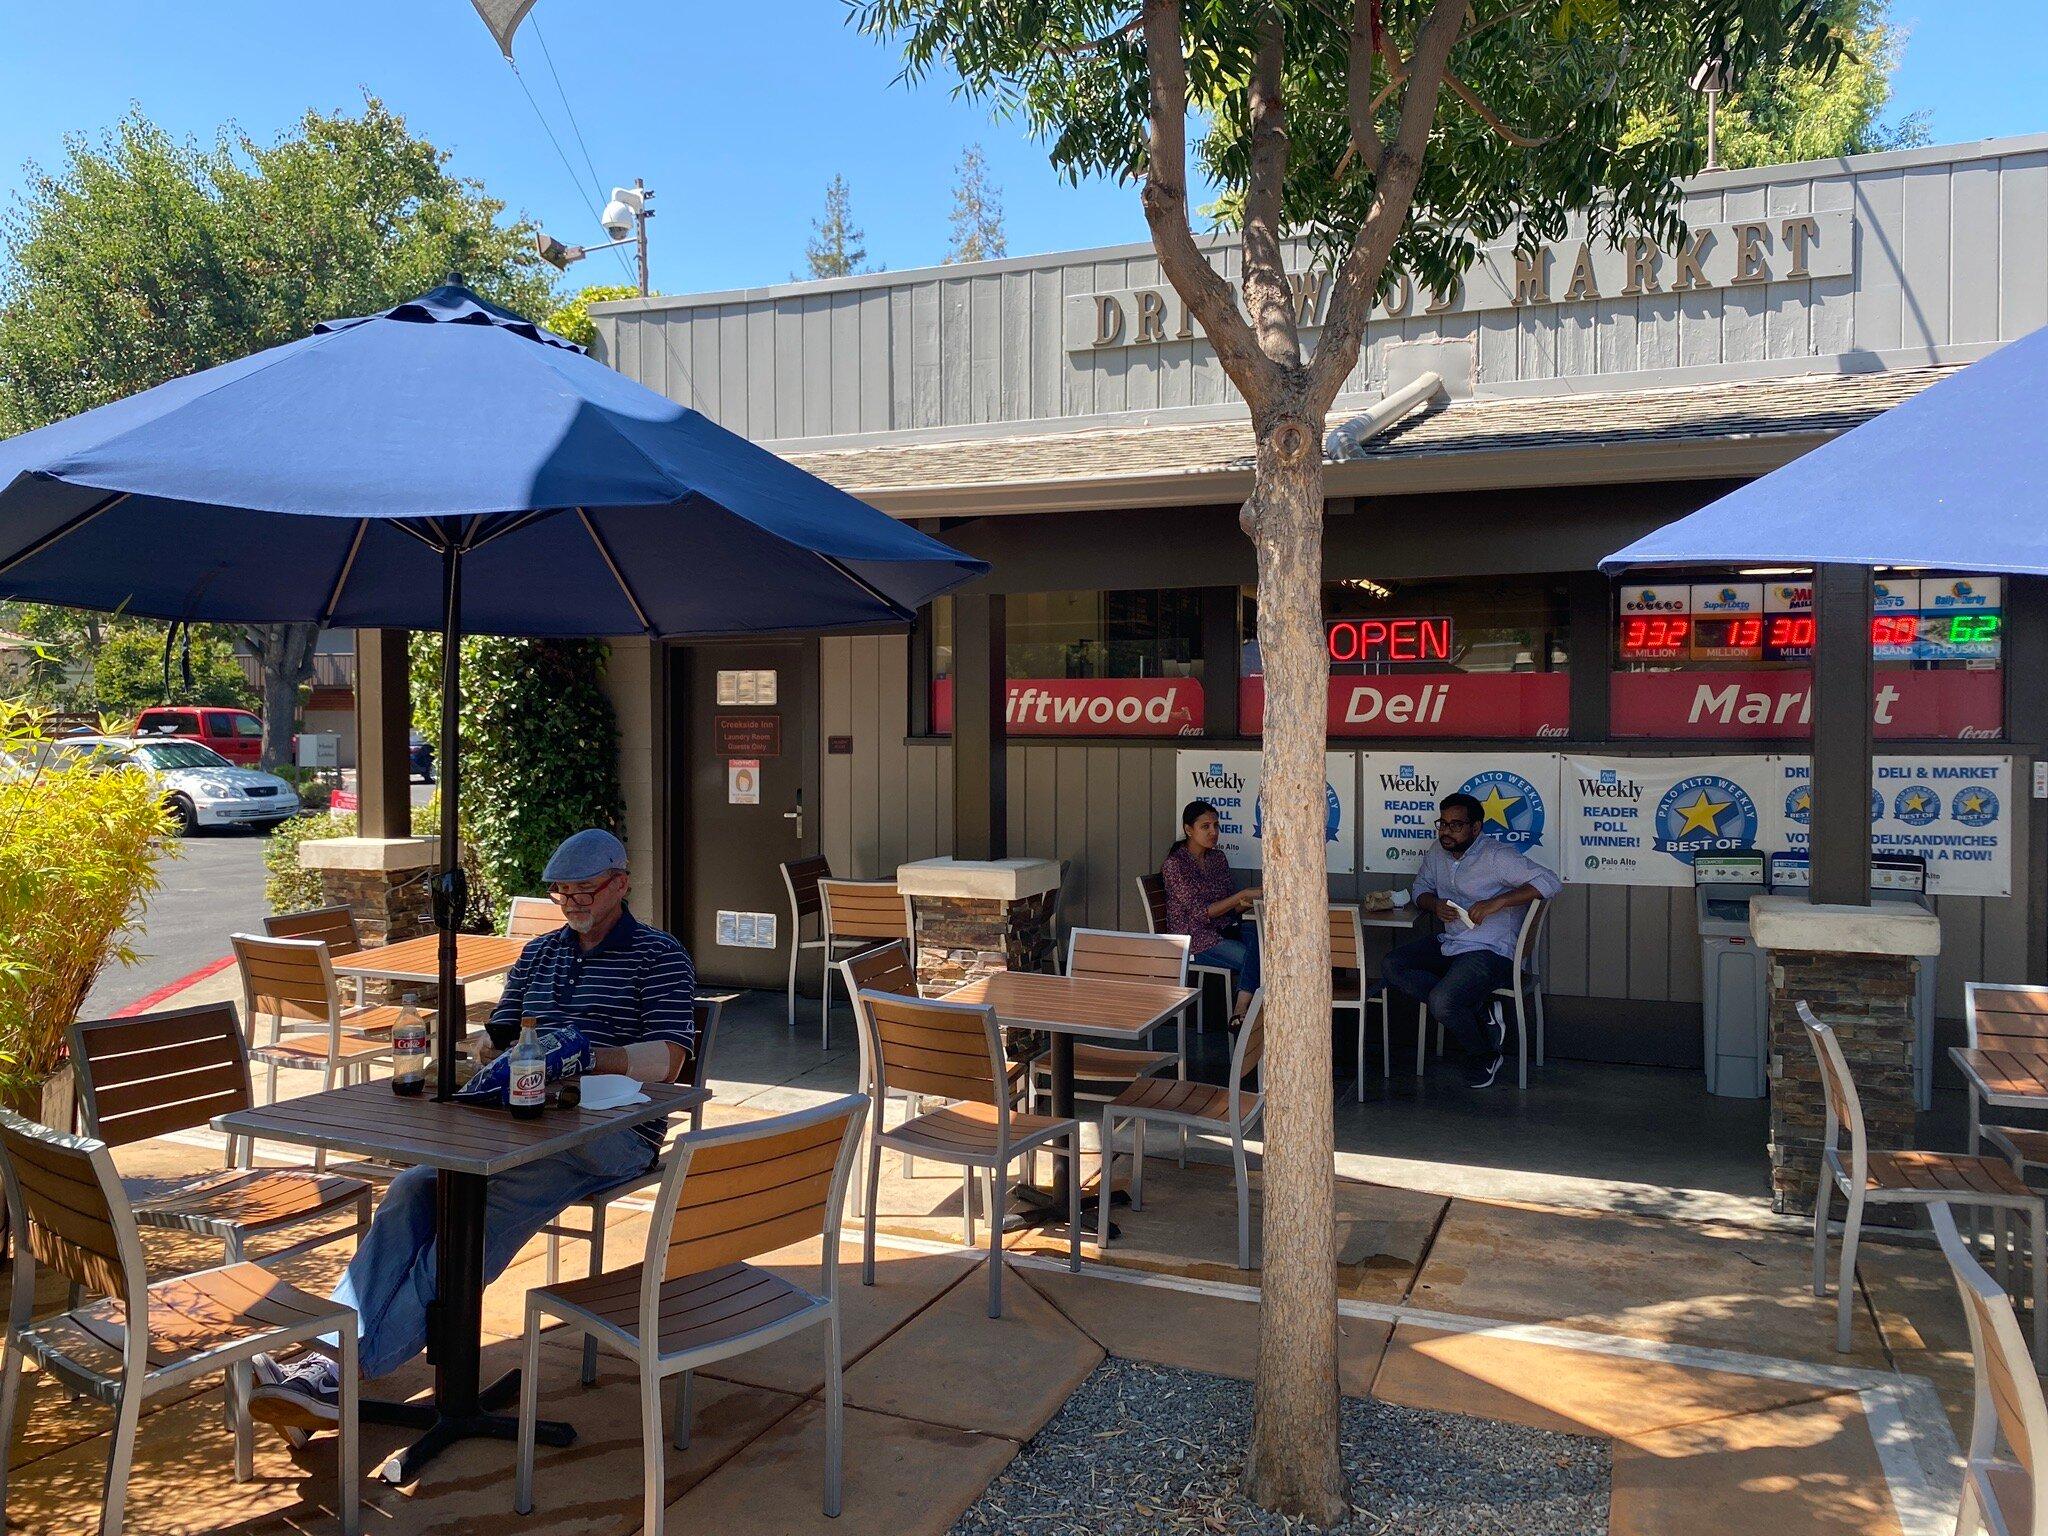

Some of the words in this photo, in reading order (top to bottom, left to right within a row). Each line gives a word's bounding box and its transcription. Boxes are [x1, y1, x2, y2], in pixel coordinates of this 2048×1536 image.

[1511, 217, 1814, 306] MARKET
[1626, 621, 1688, 647] 332
[1729, 620, 1762, 646] 13
[1950, 616, 1997, 643] 62
[1329, 620, 1448, 661] OPEN
[1635, 649, 1676, 658] MILLION
[1707, 648, 1748, 657] MILLION
[1780, 648, 1811, 657] MILLI
[1873, 646, 1913, 655] USAND
[1930, 645, 1994, 655] THOUSAND
[1006, 688, 1177, 724] iftwood
[1345, 684, 1450, 724] Deli
[1687, 684, 1900, 725] Mart
[721, 721, 759, 729] Creekside
[761, 721, 774, 729] Inn
[1878, 767, 1911, 779] DELI
[1916, 767, 1928, 779] &
[1932, 767, 1999, 780] MARKET
[1191, 771, 1246, 793] Weekly
[1379, 774, 1440, 797] Weekly
[1474, 773, 1503, 786] ALTO
[1508, 774, 1543, 812] WEEKLY
[1577, 778, 1644, 803] Weekly
[1658, 790, 1678, 818] PALO
[1681, 777, 1713, 791] ALTO
[1718, 779, 1755, 818] WEEKLY
[1384, 800, 1435, 811] READER
[1583, 806, 1638, 818] READER
[1394, 814, 1425, 825] POLL
[1593, 821, 1627, 832] POLL
[1381, 828, 1437, 841] WINNER!
[1506, 831, 1531, 842] OF
[1580, 835, 1640, 848] WINNER!
[1666, 840, 1713, 852] BEST
[1715, 839, 1742, 850] OF
[1401, 848, 1417, 856] Palo
[1919, 849, 1934, 861] IN
[1938, 849, 1949, 861] A
[1953, 850, 1992, 862] ROW!
[1601, 857, 1618, 865] Palo
[1619, 857, 1637, 866] Alto
[397, 1039, 422, 1050] Coke
